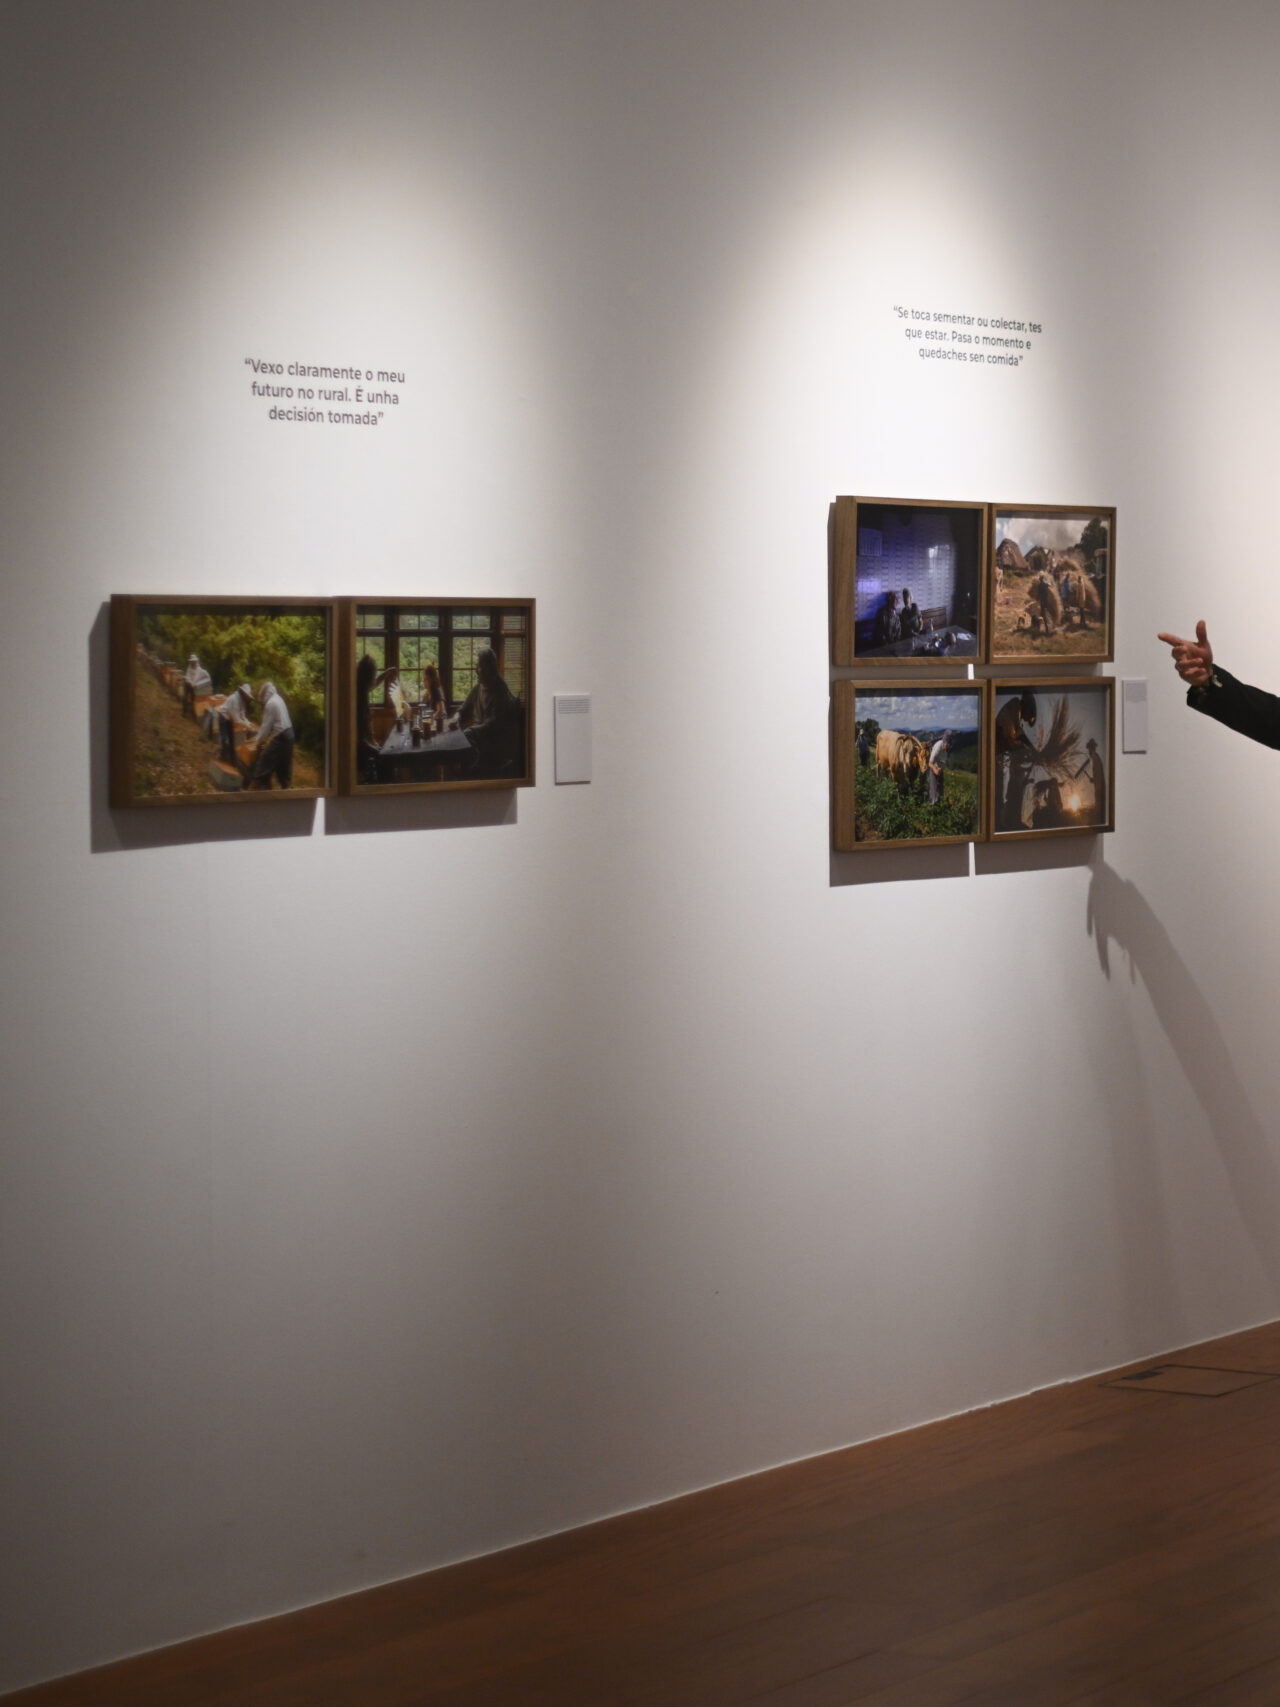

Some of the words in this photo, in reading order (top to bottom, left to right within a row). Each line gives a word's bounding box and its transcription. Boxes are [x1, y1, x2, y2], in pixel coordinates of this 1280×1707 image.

[893, 305, 909, 319] “Se
[911, 309, 931, 321] toca
[933, 312, 975, 326] sementar
[977, 317, 989, 328] ou
[990, 318, 1027, 333] colectar,
[1029, 321, 1043, 334] tes
[905, 327, 923, 339] que
[925, 330, 949, 342] estar.
[951, 330, 973, 344] Pasa
[974, 334, 981, 345] o
[982, 335, 1025, 349] momento
[1026, 340, 1033, 350] e
[918, 346, 968, 361] quedaches
[969, 351, 985, 363] sen
[987, 354, 1024, 367] comida”
[244, 357, 284, 376] “Vexo
[287, 361, 362, 380] claramente
[365, 369, 374, 382] o
[377, 369, 406, 384] meu
[251, 381, 294, 399] futuro
[297, 386, 315, 400] no
[318, 388, 352, 403] rural.
[355, 384, 364, 403] É
[367, 390, 400, 405] unha
[268, 405, 324, 424] decisión
[328, 409, 384, 426] tomada”
